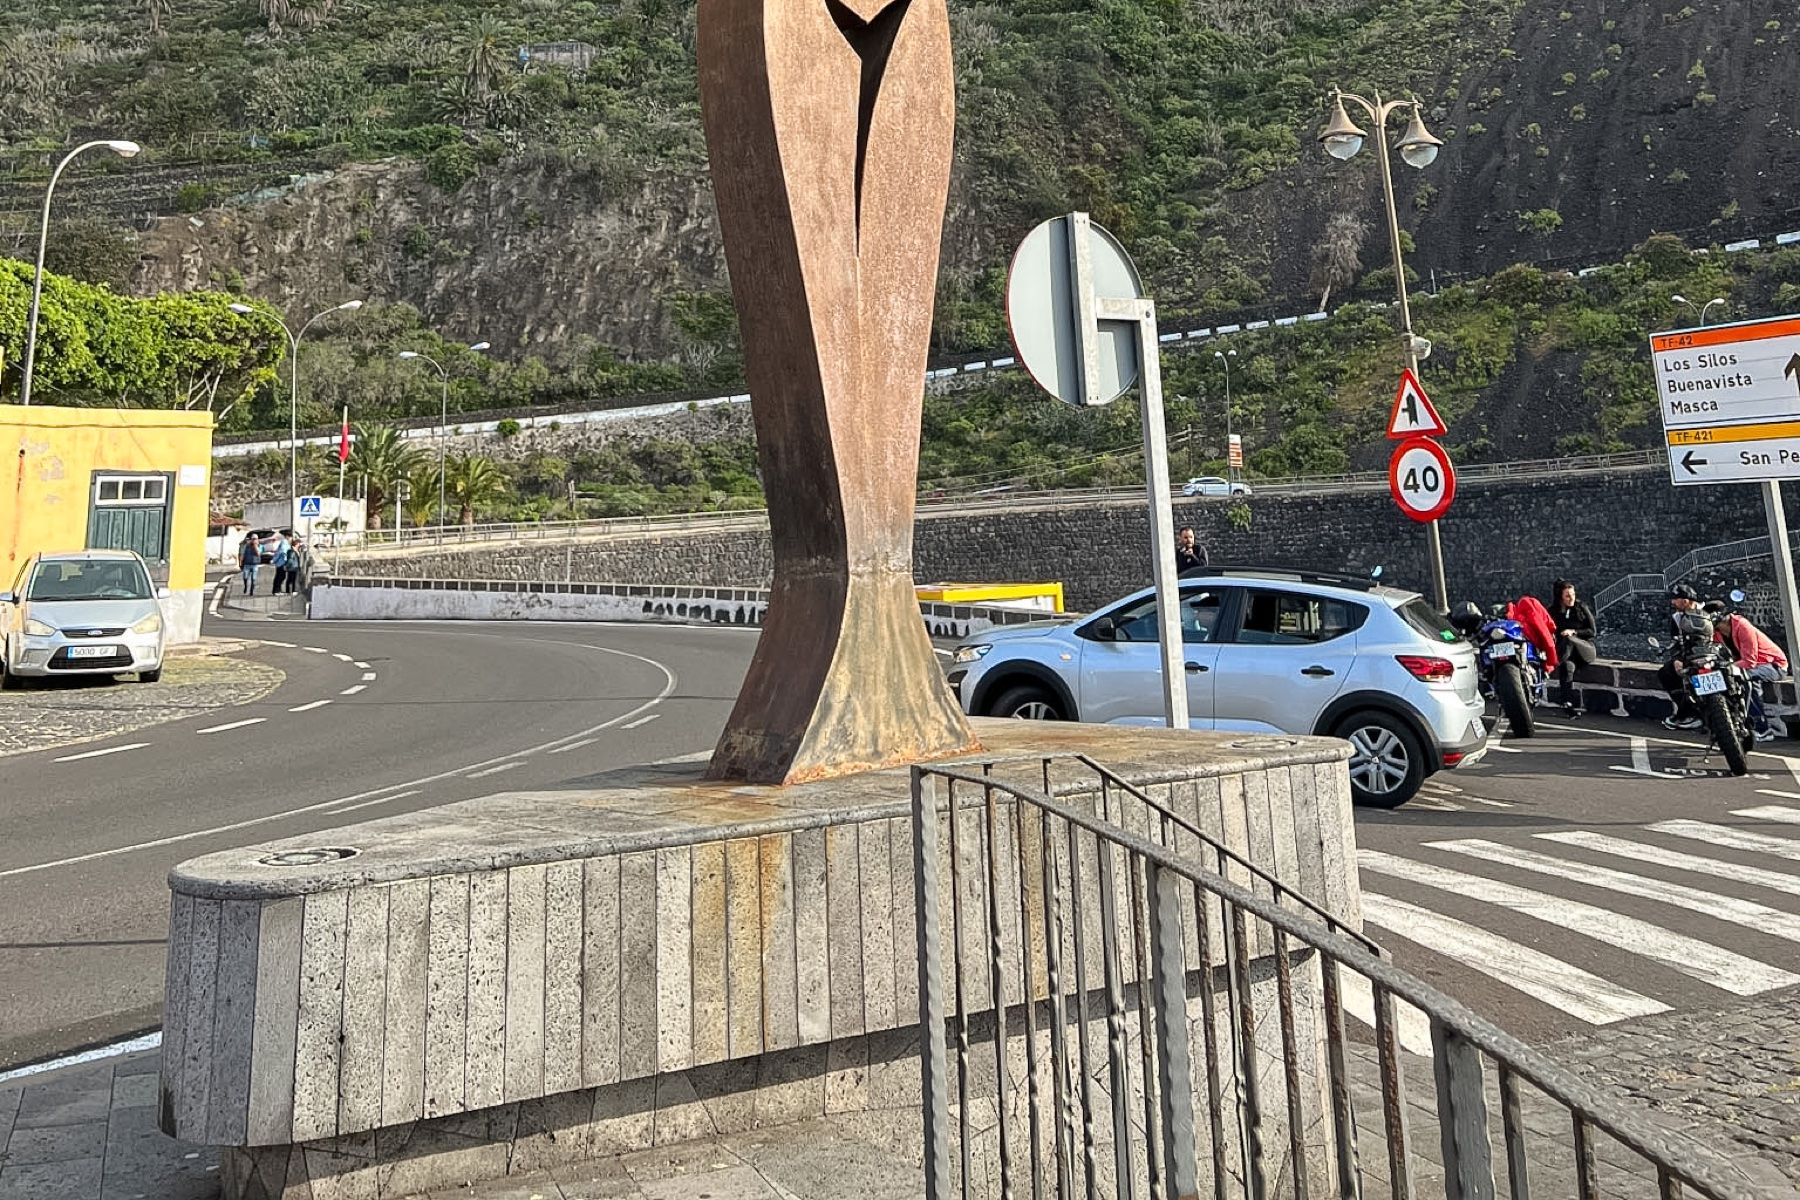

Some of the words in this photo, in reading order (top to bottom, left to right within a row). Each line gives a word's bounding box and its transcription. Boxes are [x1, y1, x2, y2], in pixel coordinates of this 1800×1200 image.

[1661, 336, 1693, 348] TF-42
[1664, 359, 1690, 372] Los
[1698, 353, 1737, 368] Silos
[1668, 373, 1752, 393] Buenavista
[1670, 400, 1718, 415] Masca
[1675, 431, 1713, 442] TF-421
[1740, 451, 1772, 465] San
[1404, 466, 1439, 493] 40
